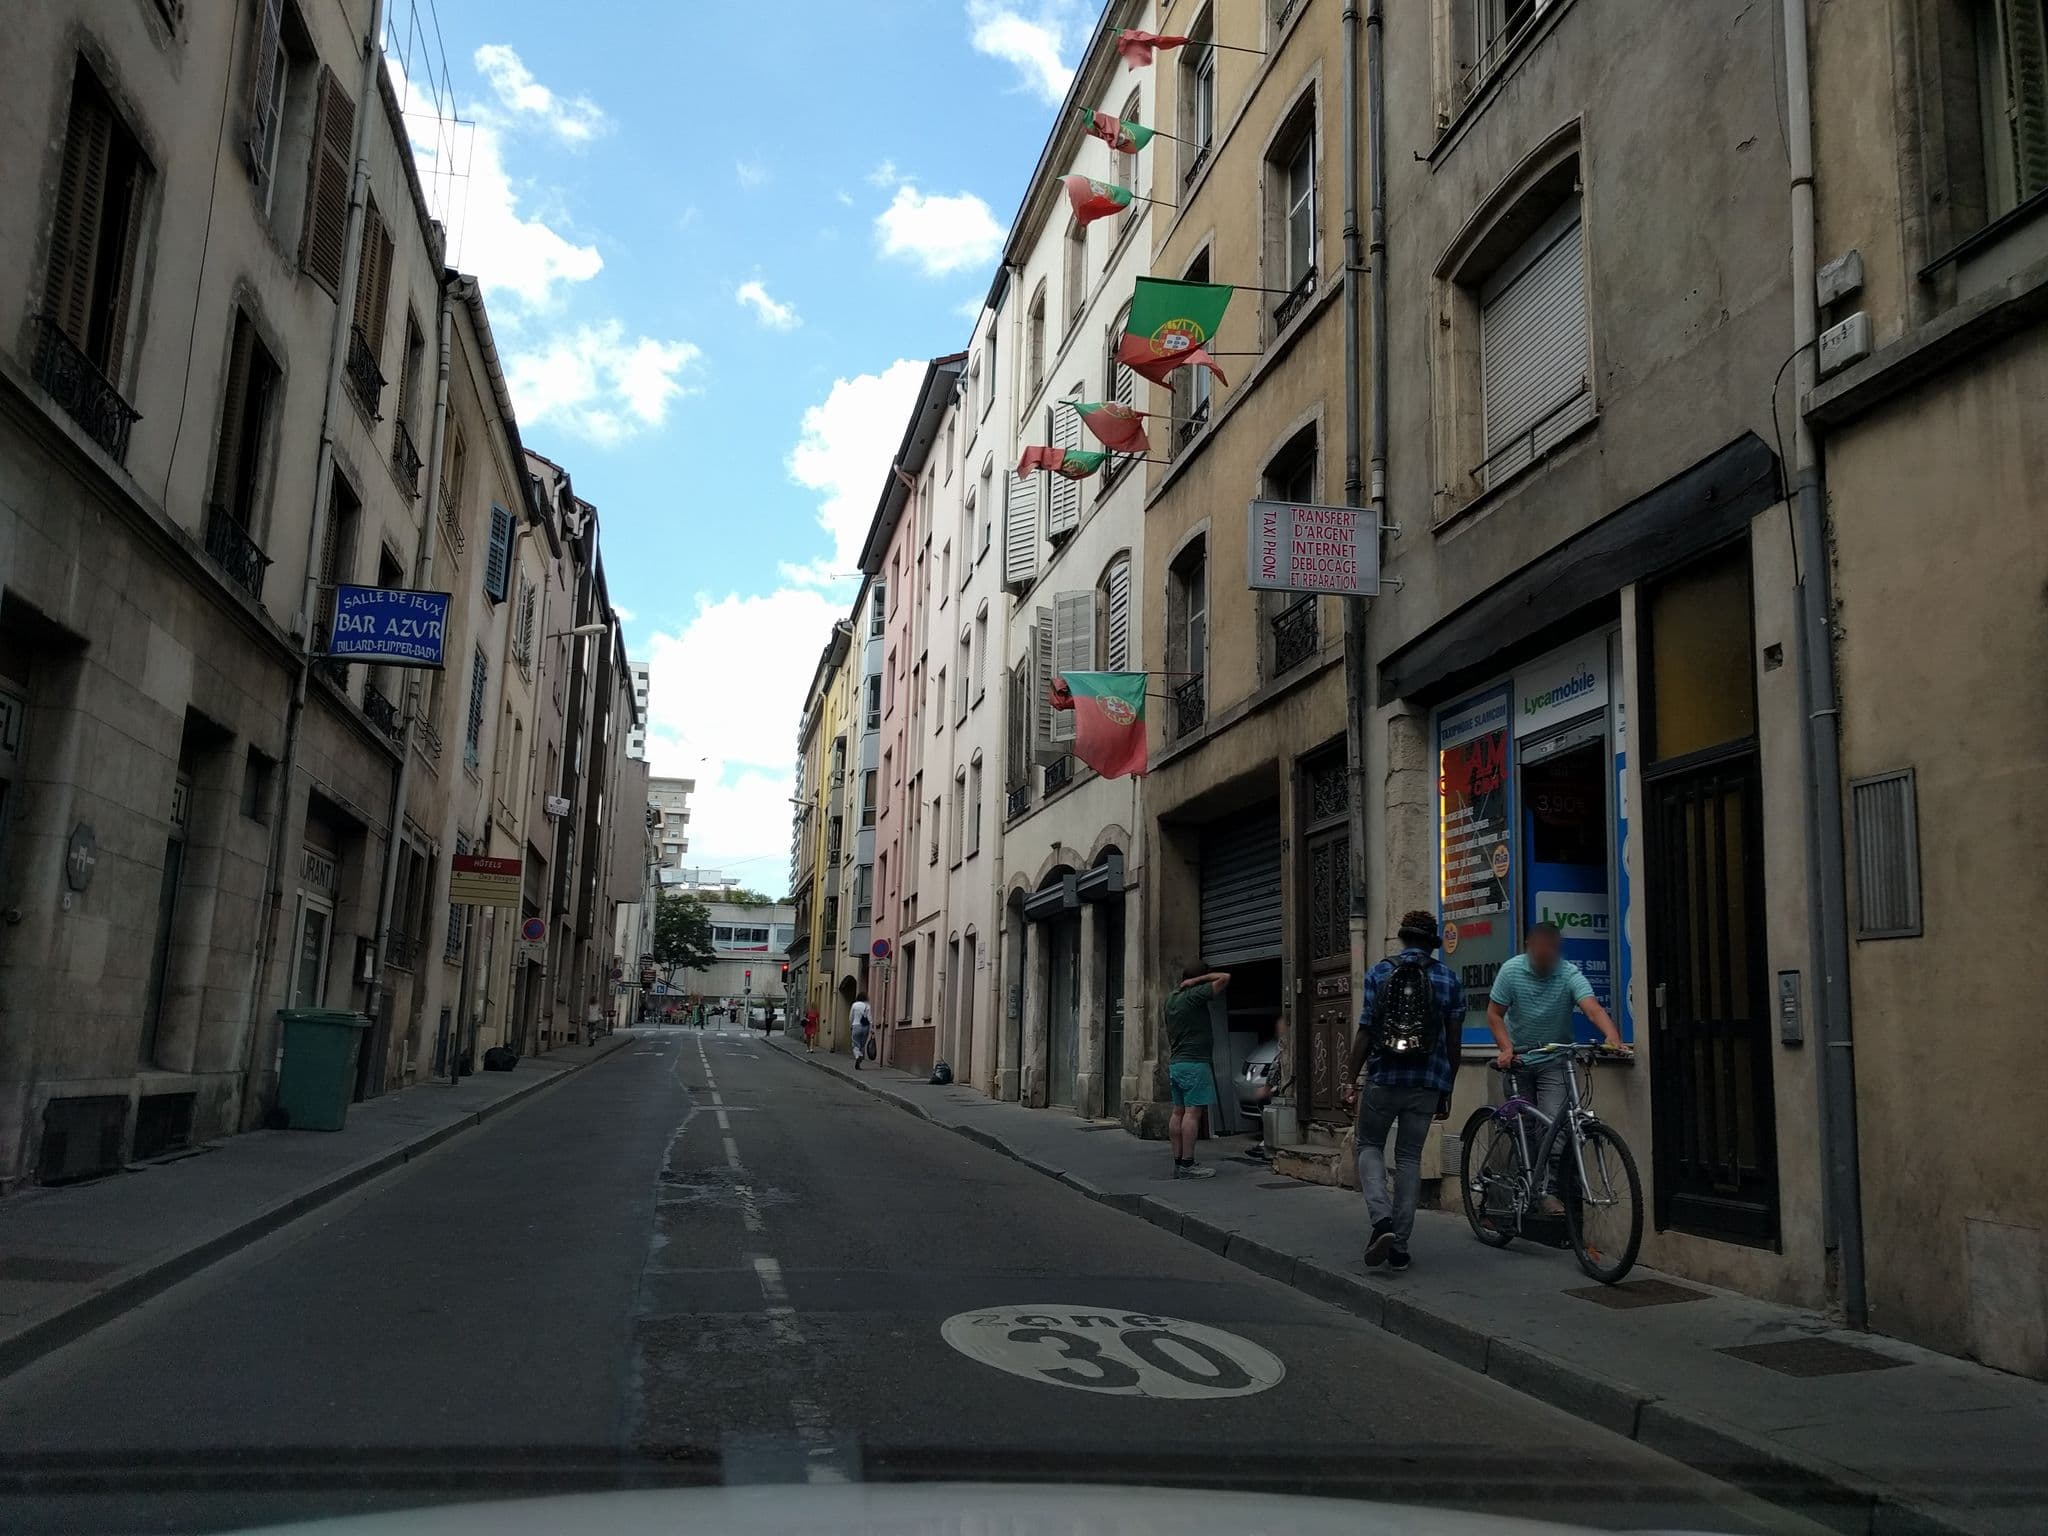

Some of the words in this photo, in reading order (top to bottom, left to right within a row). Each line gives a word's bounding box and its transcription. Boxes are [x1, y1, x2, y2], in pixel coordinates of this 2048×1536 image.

[1263, 511, 1277, 537] TAXI
[1290, 508, 1357, 526] TRANSFERT
[1294, 524, 1356, 542] D'ARGENT
[1262, 540, 1277, 580] PHONE
[1291, 540, 1357, 559] INTERNET
[1291, 556, 1357, 574] DEBLOCAGE
[1290, 572, 1300, 587] ET
[1303, 572, 1357, 590] REPARATION
[343, 591, 385, 609] SALLE
[389, 591, 407, 604] DE
[410, 595, 443, 617] JEUX
[337, 613, 376, 634] BAR
[384, 617, 441, 639] AZUR
[336, 639, 440, 660] BILLARD-FLIPPER-BABY
[1524, 671, 1596, 716] Lycamobile
[1585, 960, 1607, 972] SIM
[1007, 1327, 1252, 1390] 30
